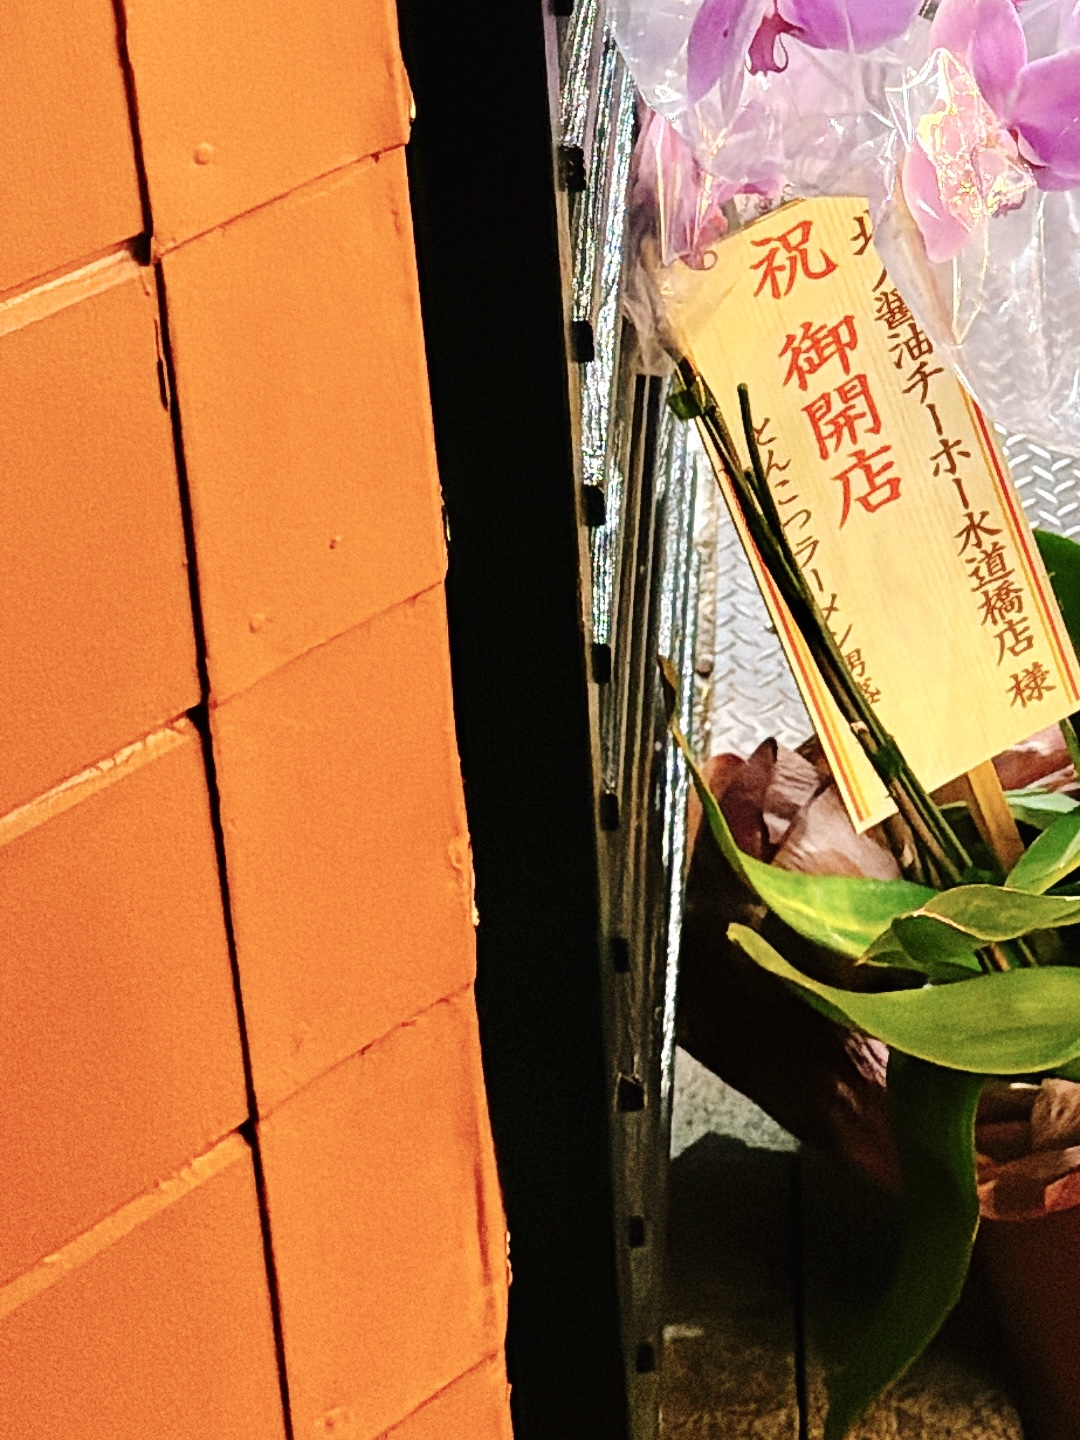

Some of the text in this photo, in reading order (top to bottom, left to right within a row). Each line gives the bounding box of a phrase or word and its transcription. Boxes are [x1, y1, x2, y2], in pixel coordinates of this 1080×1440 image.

[747, 219, 902, 530] 祝 御開店
[849, 208, 1057, 709] 醤油チーホー水道橋店 様
